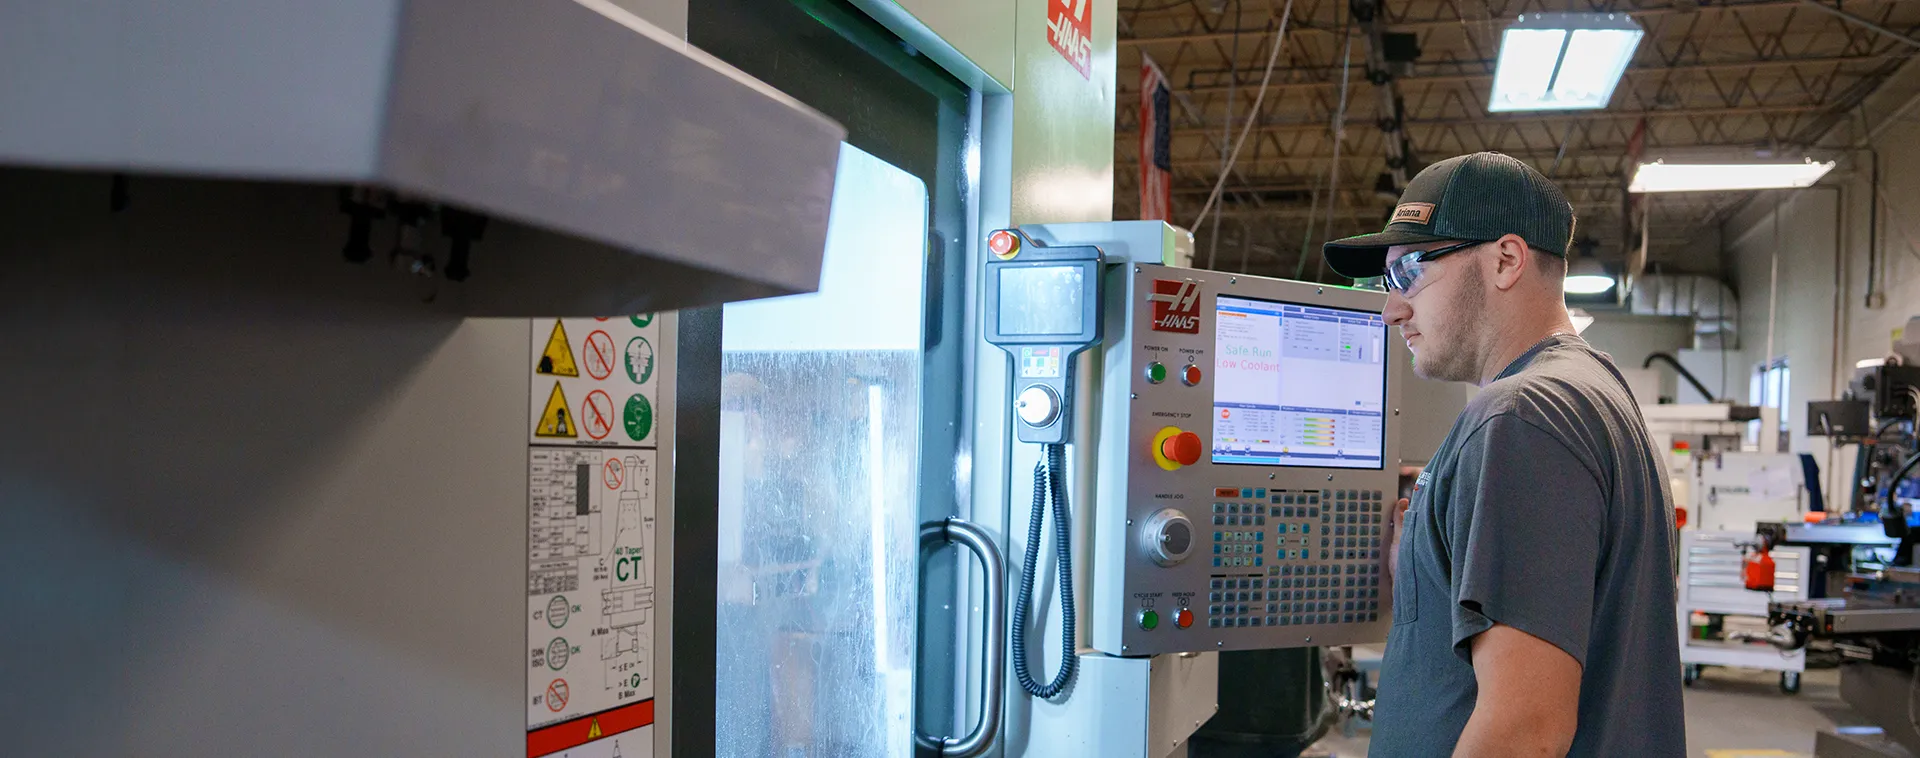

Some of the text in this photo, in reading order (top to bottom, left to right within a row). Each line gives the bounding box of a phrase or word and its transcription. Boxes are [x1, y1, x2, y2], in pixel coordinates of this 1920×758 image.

[1047, 12, 1091, 67] HAAS
[1396, 208, 1421, 217] Ariana
[1155, 314, 1200, 330] HAAS
[1225, 345, 1272, 357] Safe Run
[1216, 359, 1281, 373] Low Coolant
[625, 546, 642, 555] Taper
[616, 556, 642, 581] CT
[533, 604, 582, 620] CT OK
[532, 646, 581, 658] DIN OK
[532, 659, 545, 668] ISO
